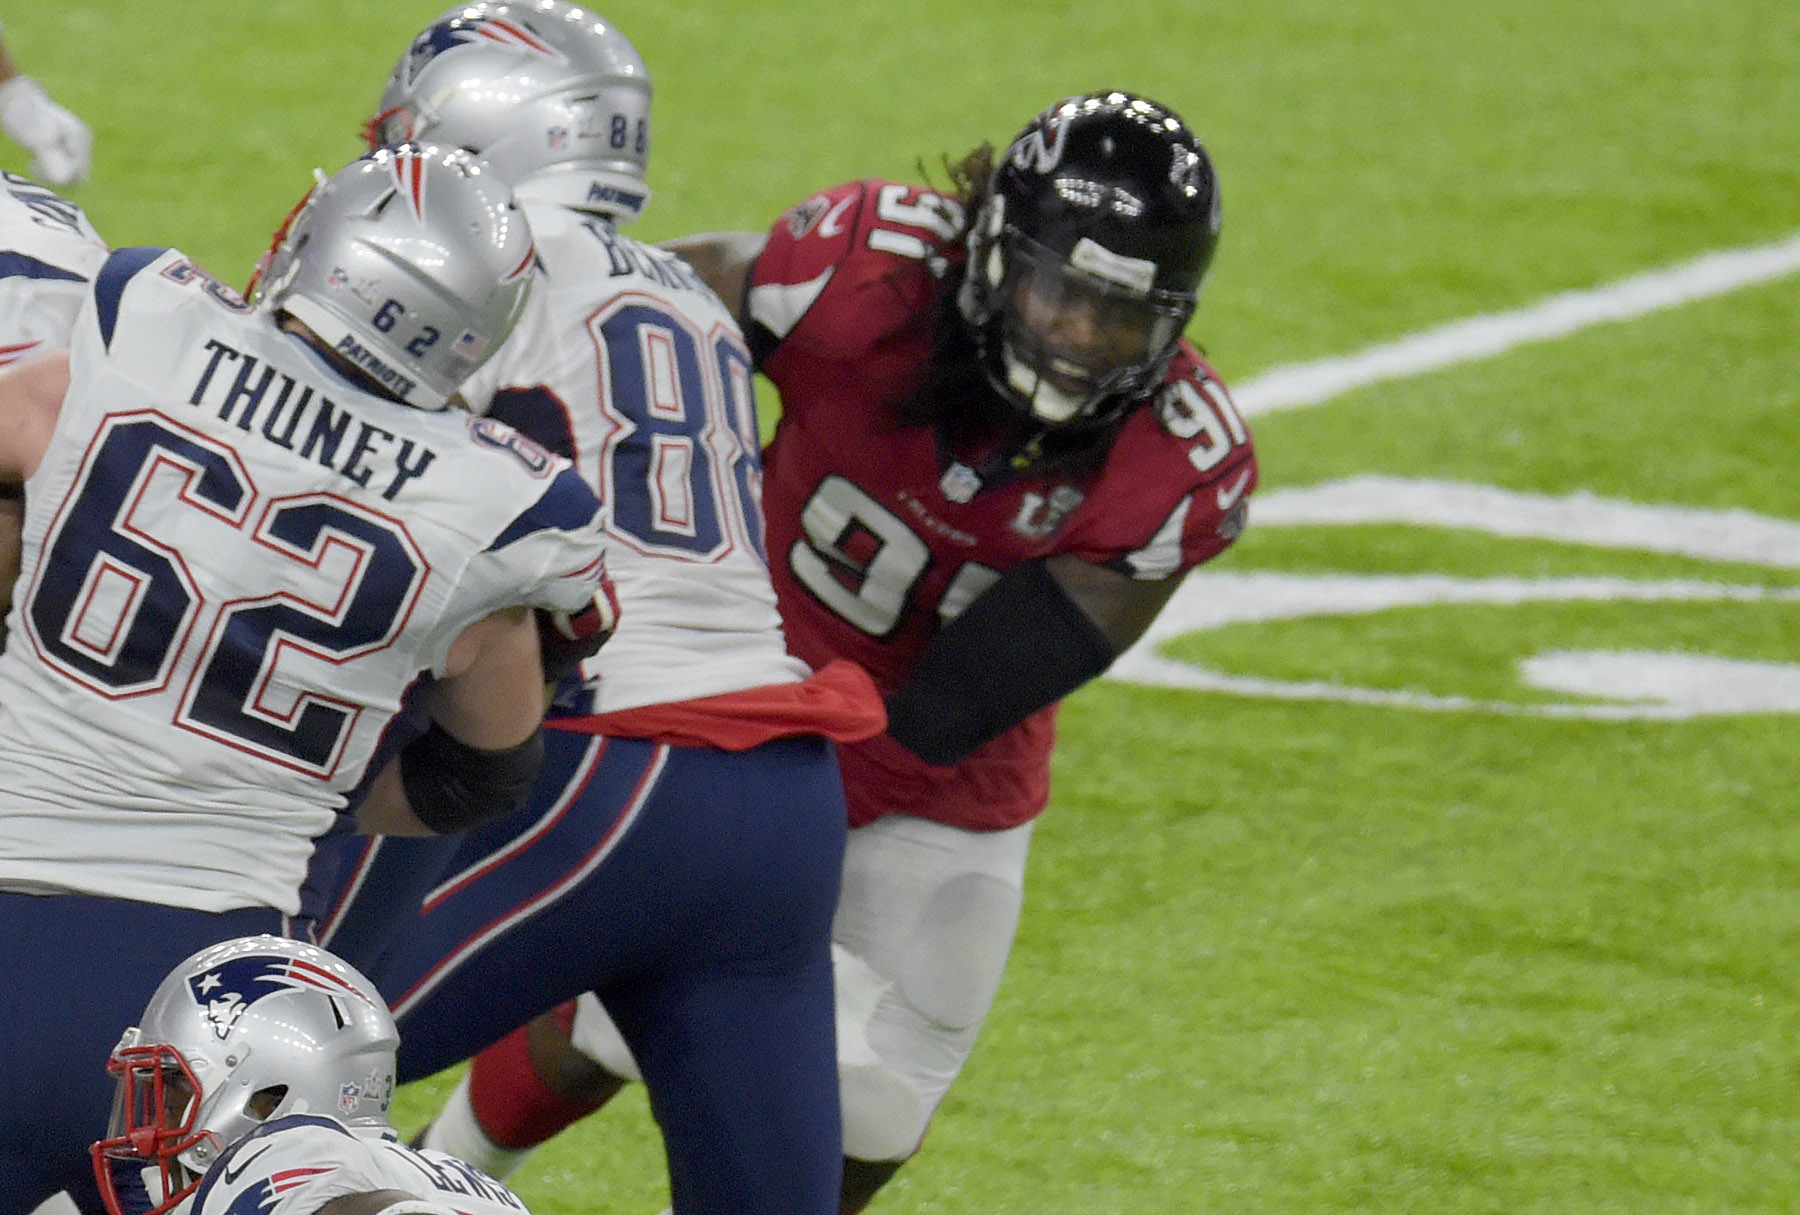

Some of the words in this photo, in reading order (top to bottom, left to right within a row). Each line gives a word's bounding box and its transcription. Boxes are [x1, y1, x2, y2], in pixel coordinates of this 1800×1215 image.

[371, 298, 441, 359] 62
[188, 338, 437, 502] THUNEY
[1156, 379, 1247, 472] 91
[20, 407, 432, 783] 62
